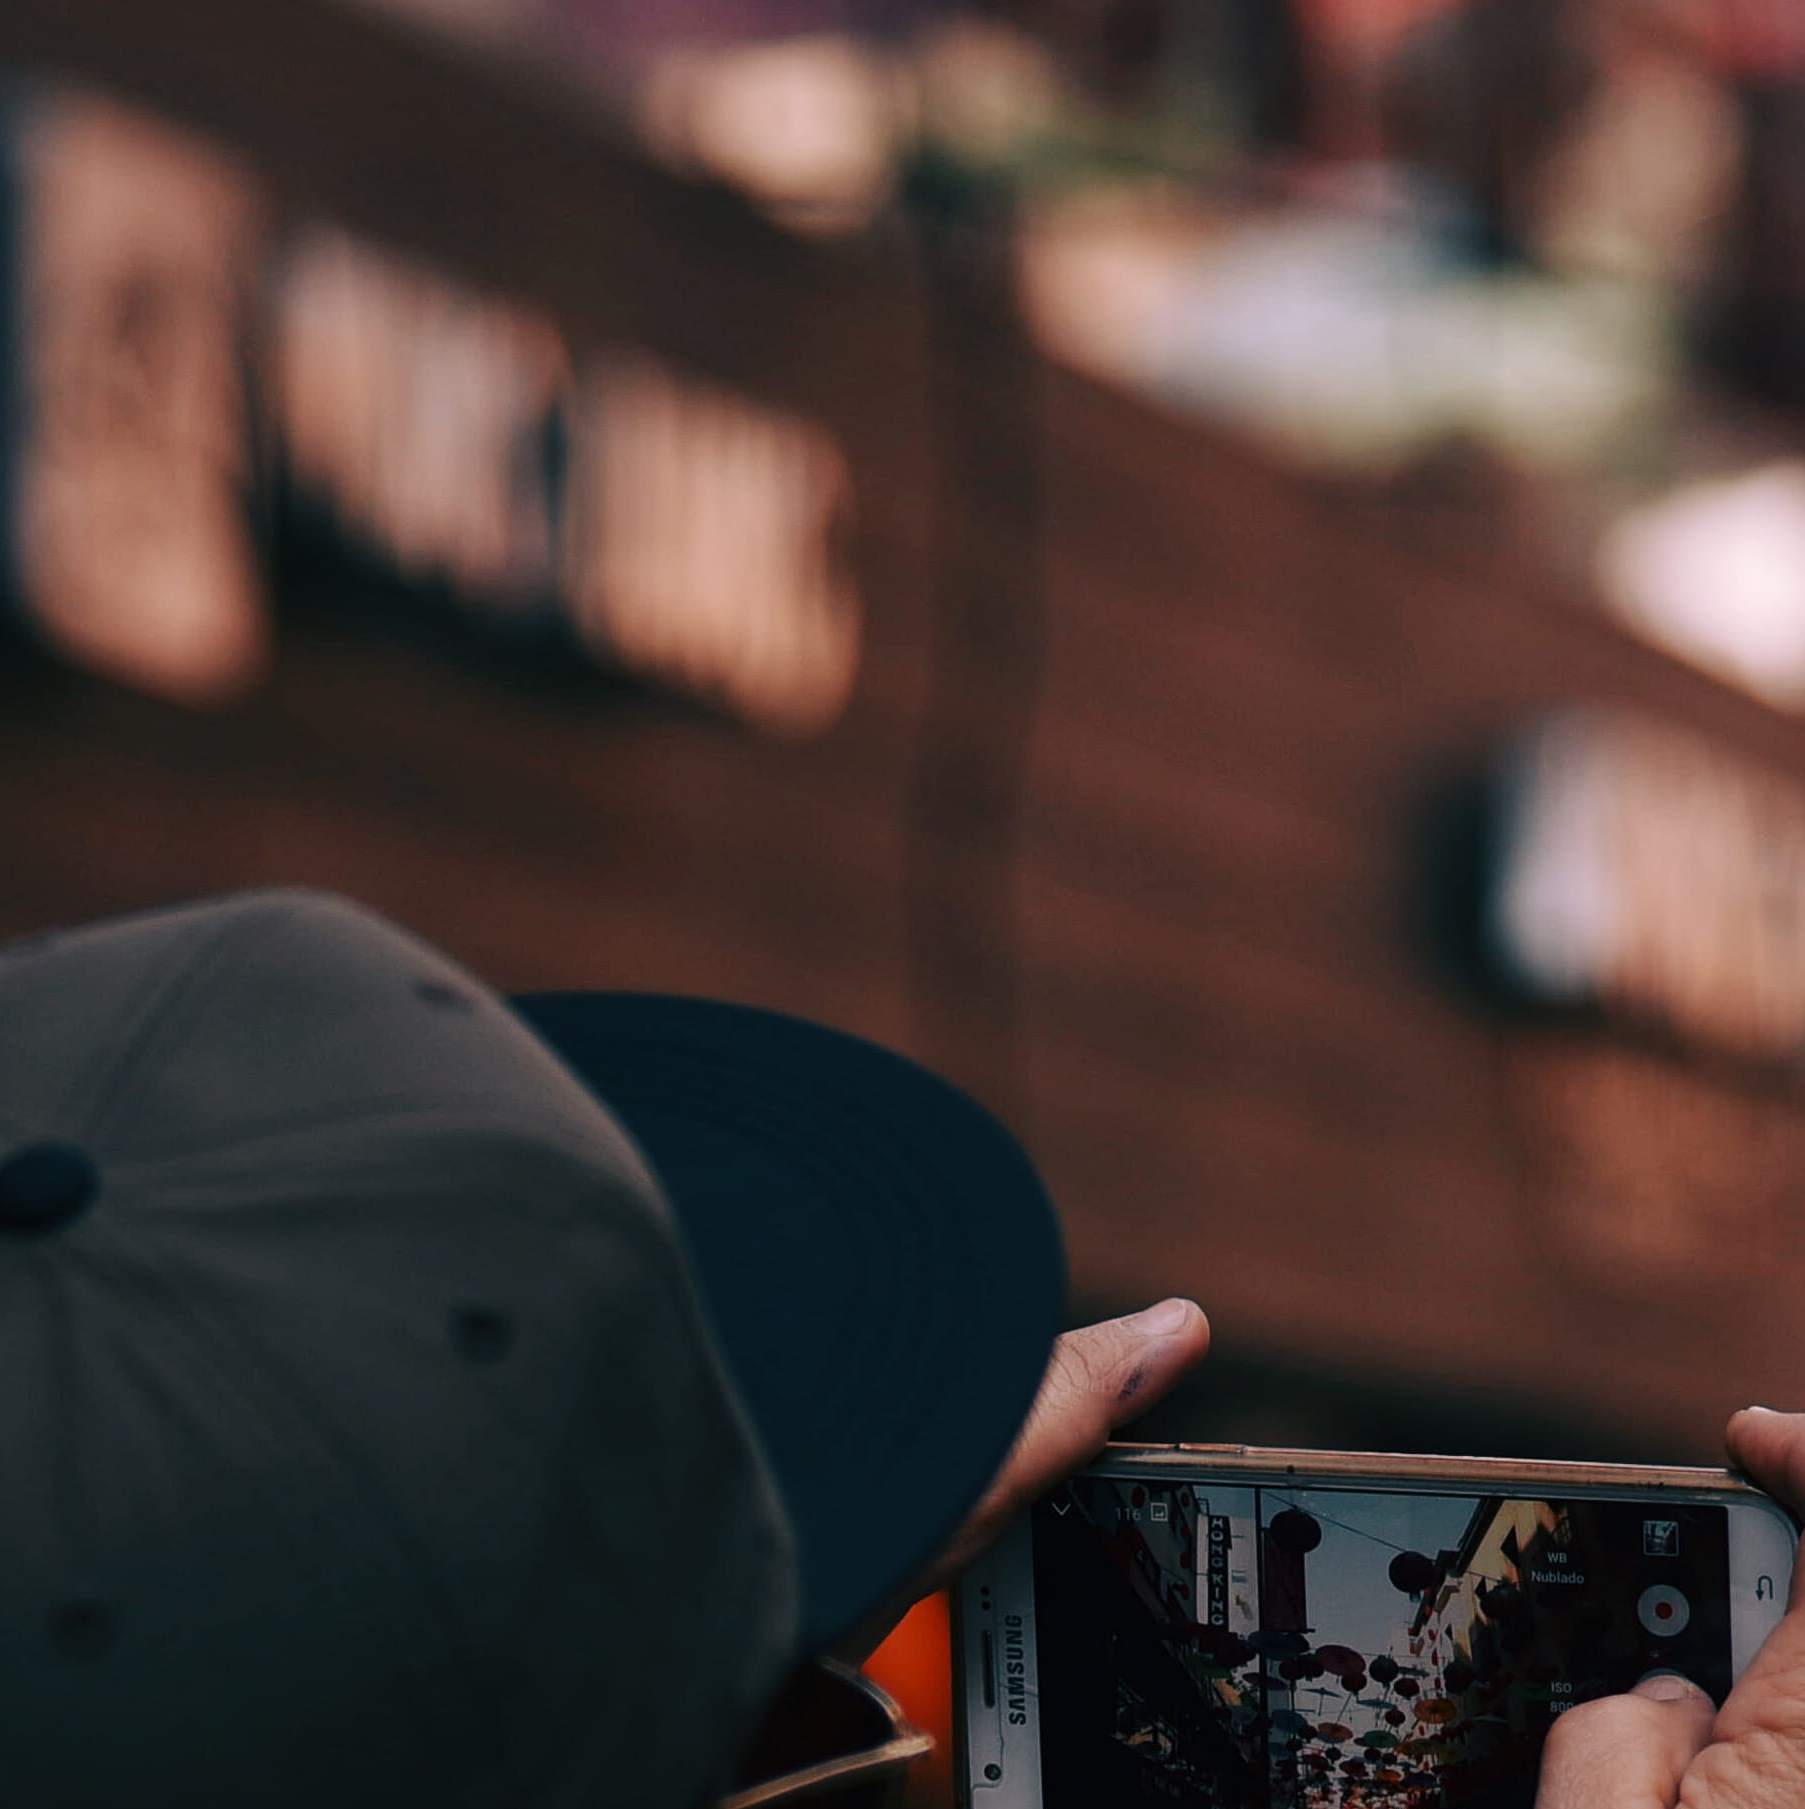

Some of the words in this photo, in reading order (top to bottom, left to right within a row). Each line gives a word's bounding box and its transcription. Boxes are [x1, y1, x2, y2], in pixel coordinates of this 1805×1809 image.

[1114, 1507, 1141, 1521] 116
[1547, 1551, 1568, 1564] WB
[1530, 1570, 1585, 1585] Nublado
[1005, 1614, 1026, 1726] SAMSUNG
[1550, 1681, 1572, 1694] ISO
